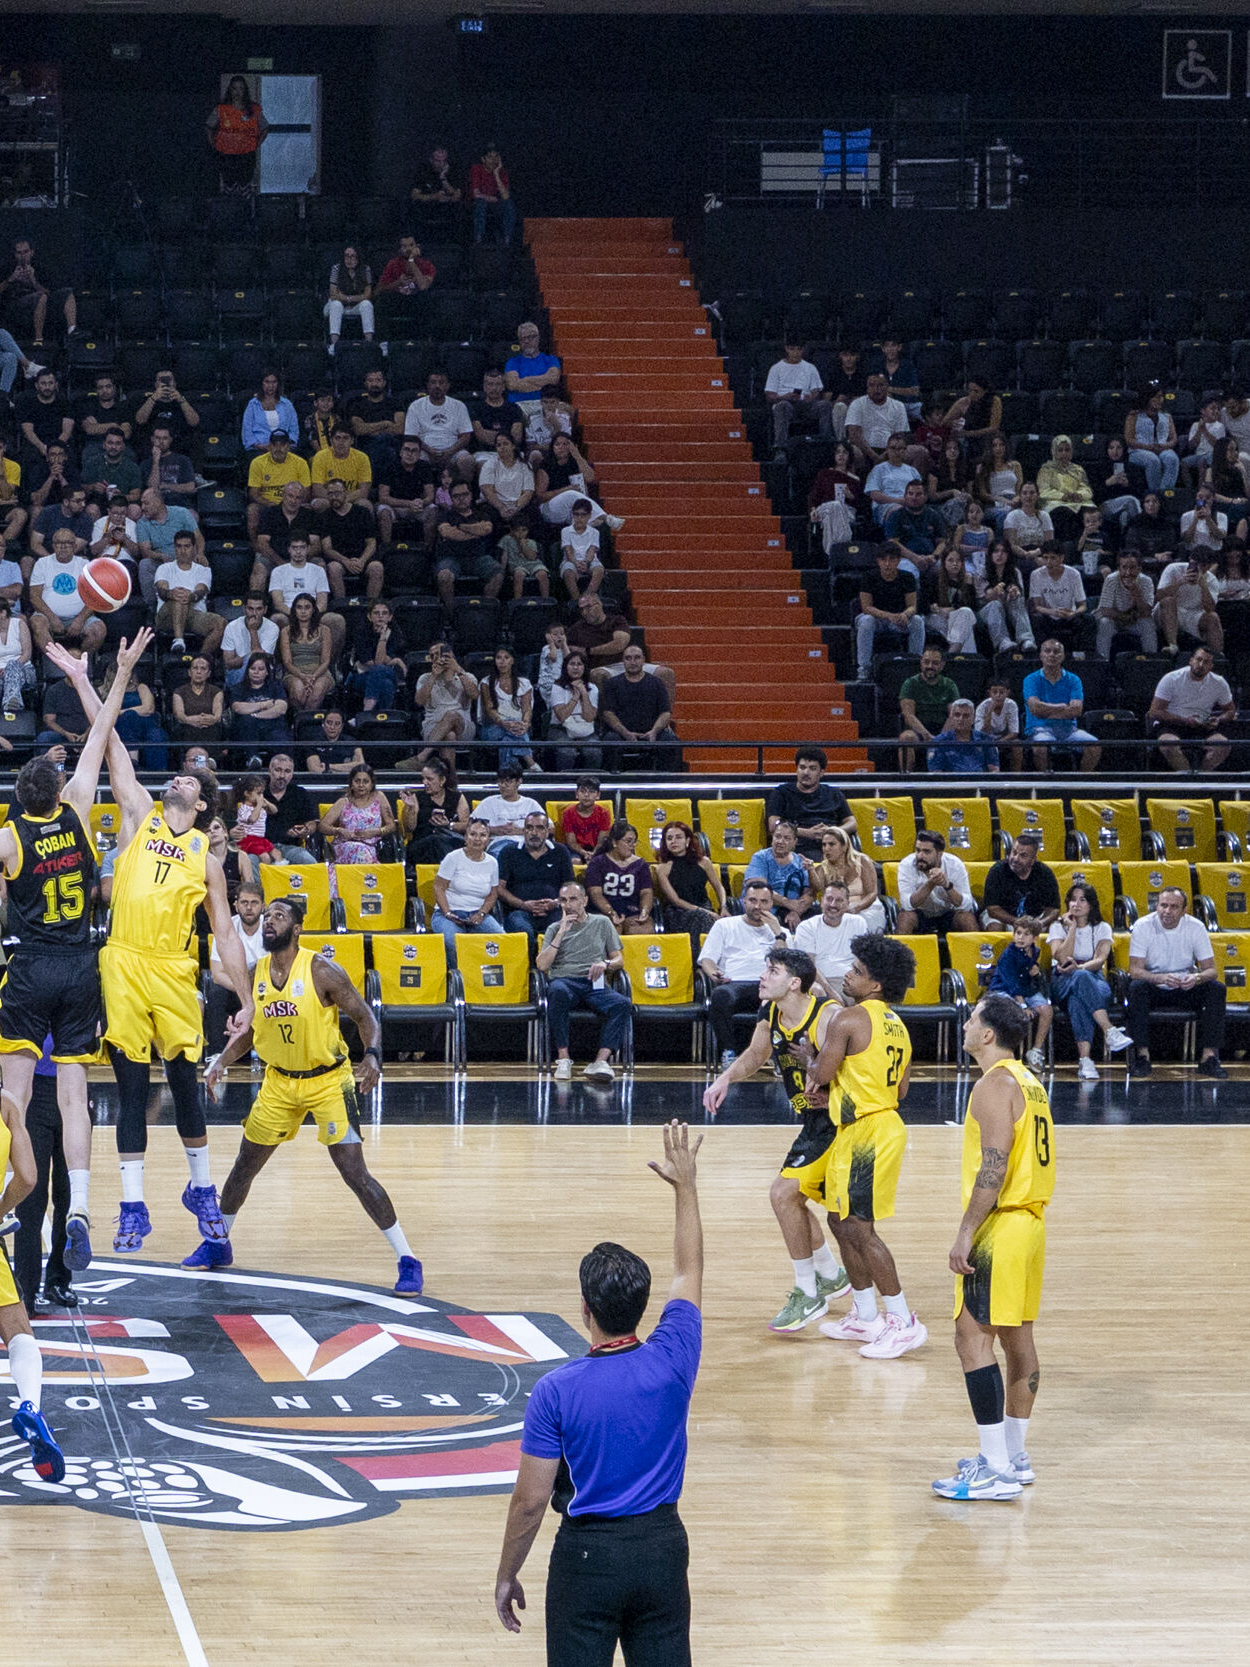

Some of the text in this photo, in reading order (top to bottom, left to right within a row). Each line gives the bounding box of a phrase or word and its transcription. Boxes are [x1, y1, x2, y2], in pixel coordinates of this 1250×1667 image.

[34, 831, 76, 860] ÇOBAN
[145, 838, 186, 862] MSK
[153, 860, 172, 885] 17
[603, 872, 635, 897] 23
[42, 870, 85, 924] 15
[263, 1000, 299, 1018] MSK
[278, 1024, 295, 1045] 12
[883, 1022, 905, 1039] SMITH
[1034, 1114, 1050, 1167] 13
[6, 1395, 211, 1411] SPOR
[272, 1392, 531, 1410] ERSİN
